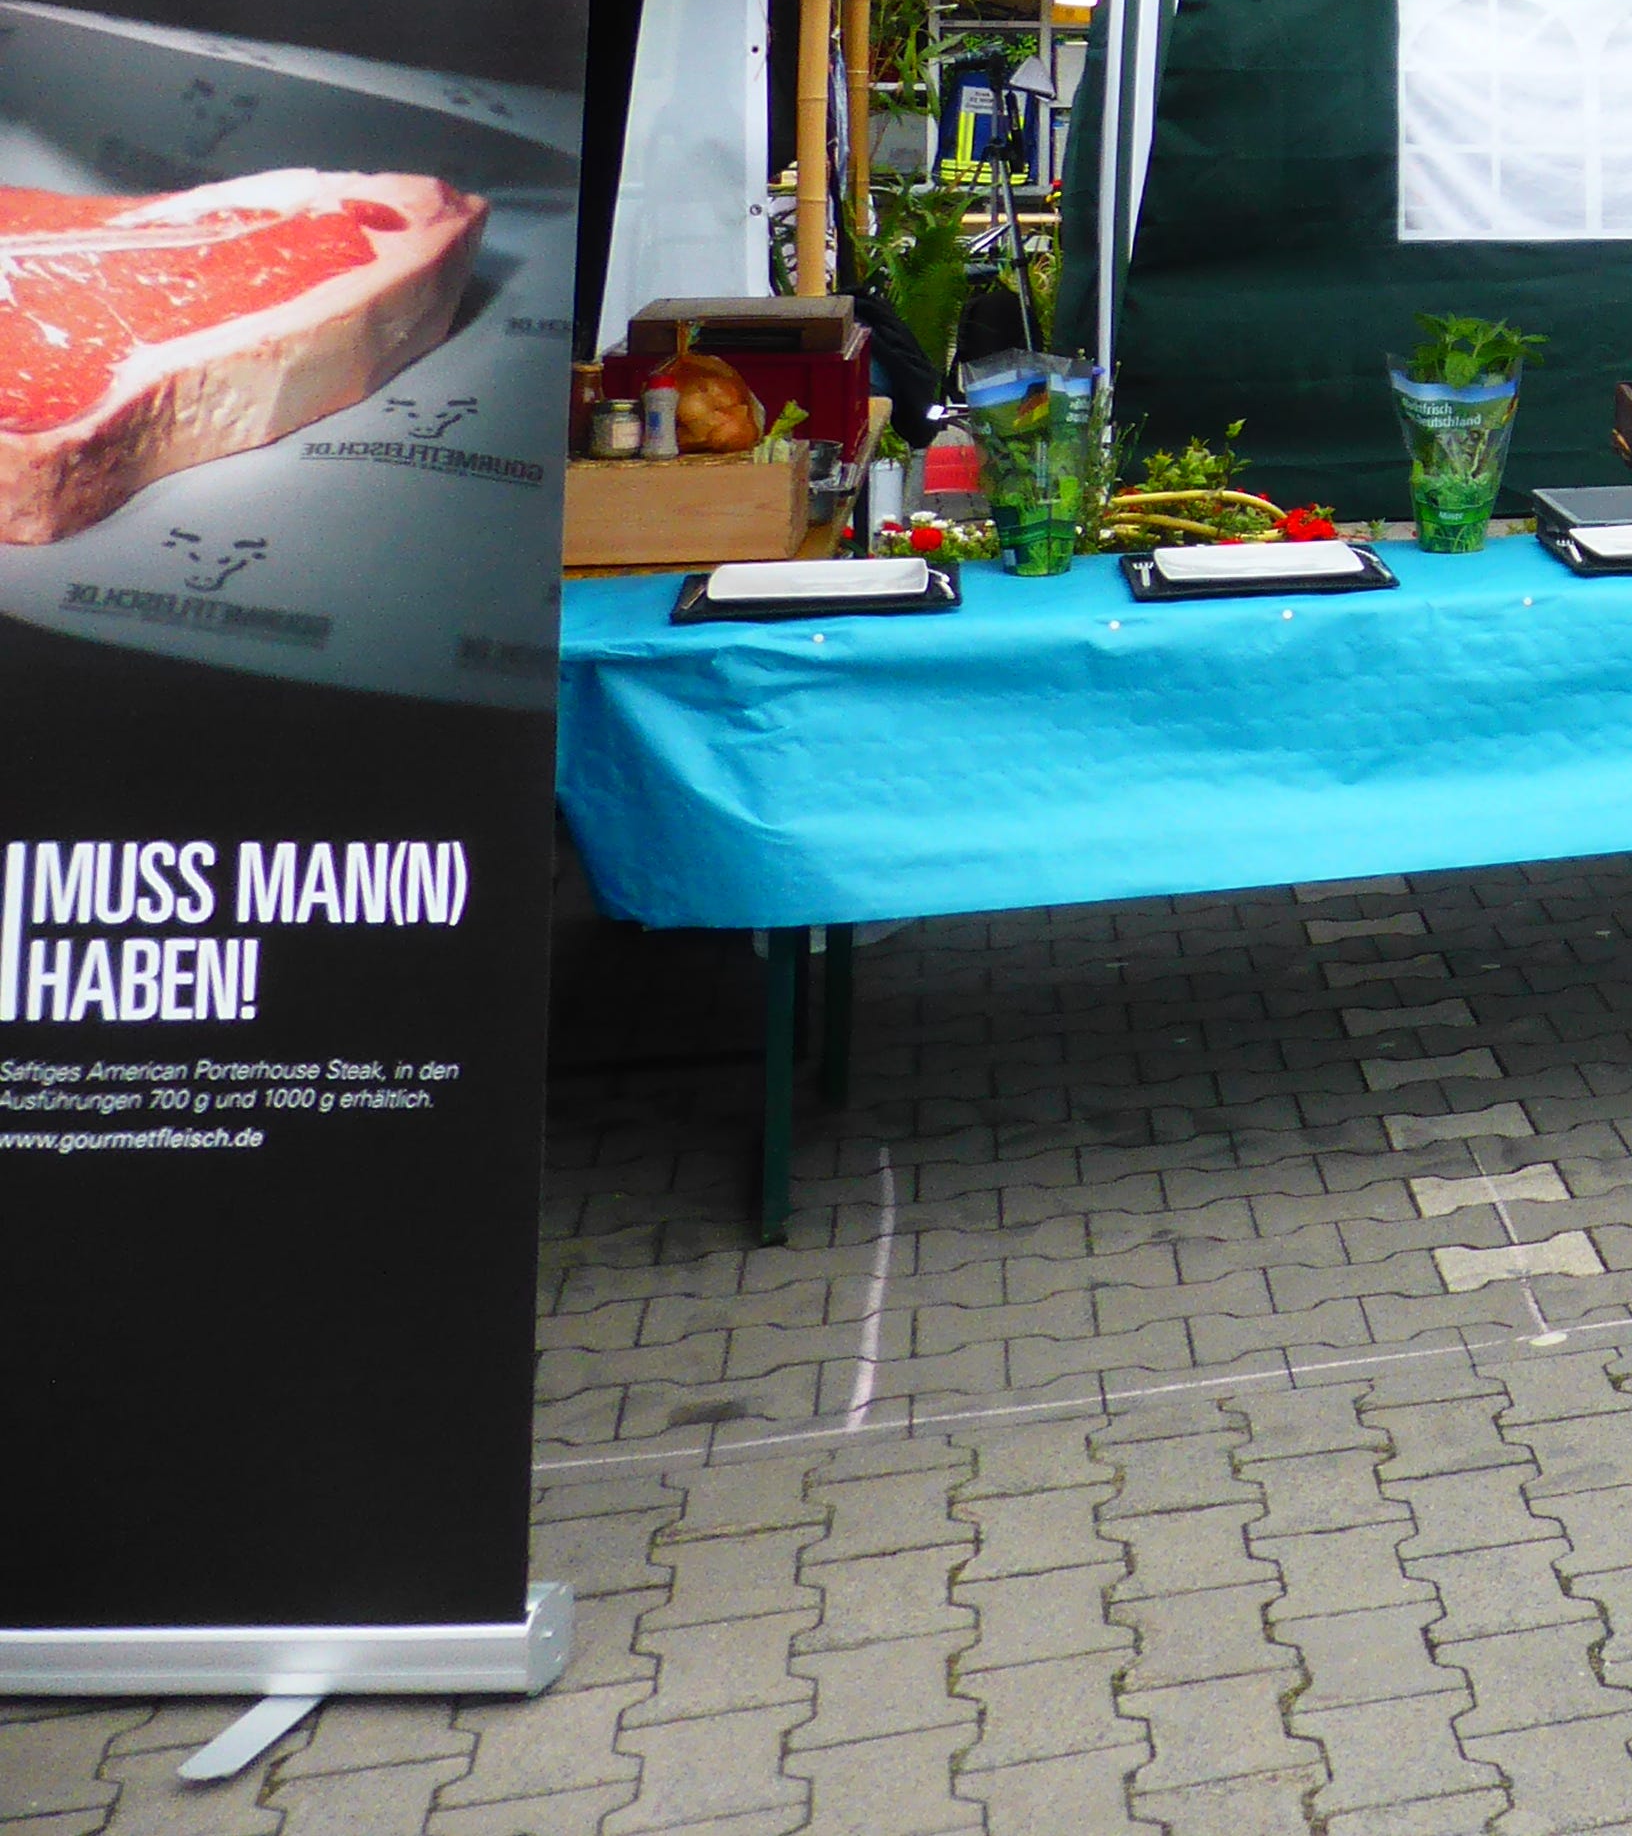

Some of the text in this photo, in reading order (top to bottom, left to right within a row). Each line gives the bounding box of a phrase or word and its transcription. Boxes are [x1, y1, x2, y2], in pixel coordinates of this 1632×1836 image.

[32, 840, 469, 926] MUSS MAN(N)
[26, 938, 260, 1022] HABEN!
[0, 1058, 460, 1085] Saftiges American Porterhouse Steak, in den
[0, 1087, 435, 1114] Ausführungen 700 g und 1000 g erhältlich.
